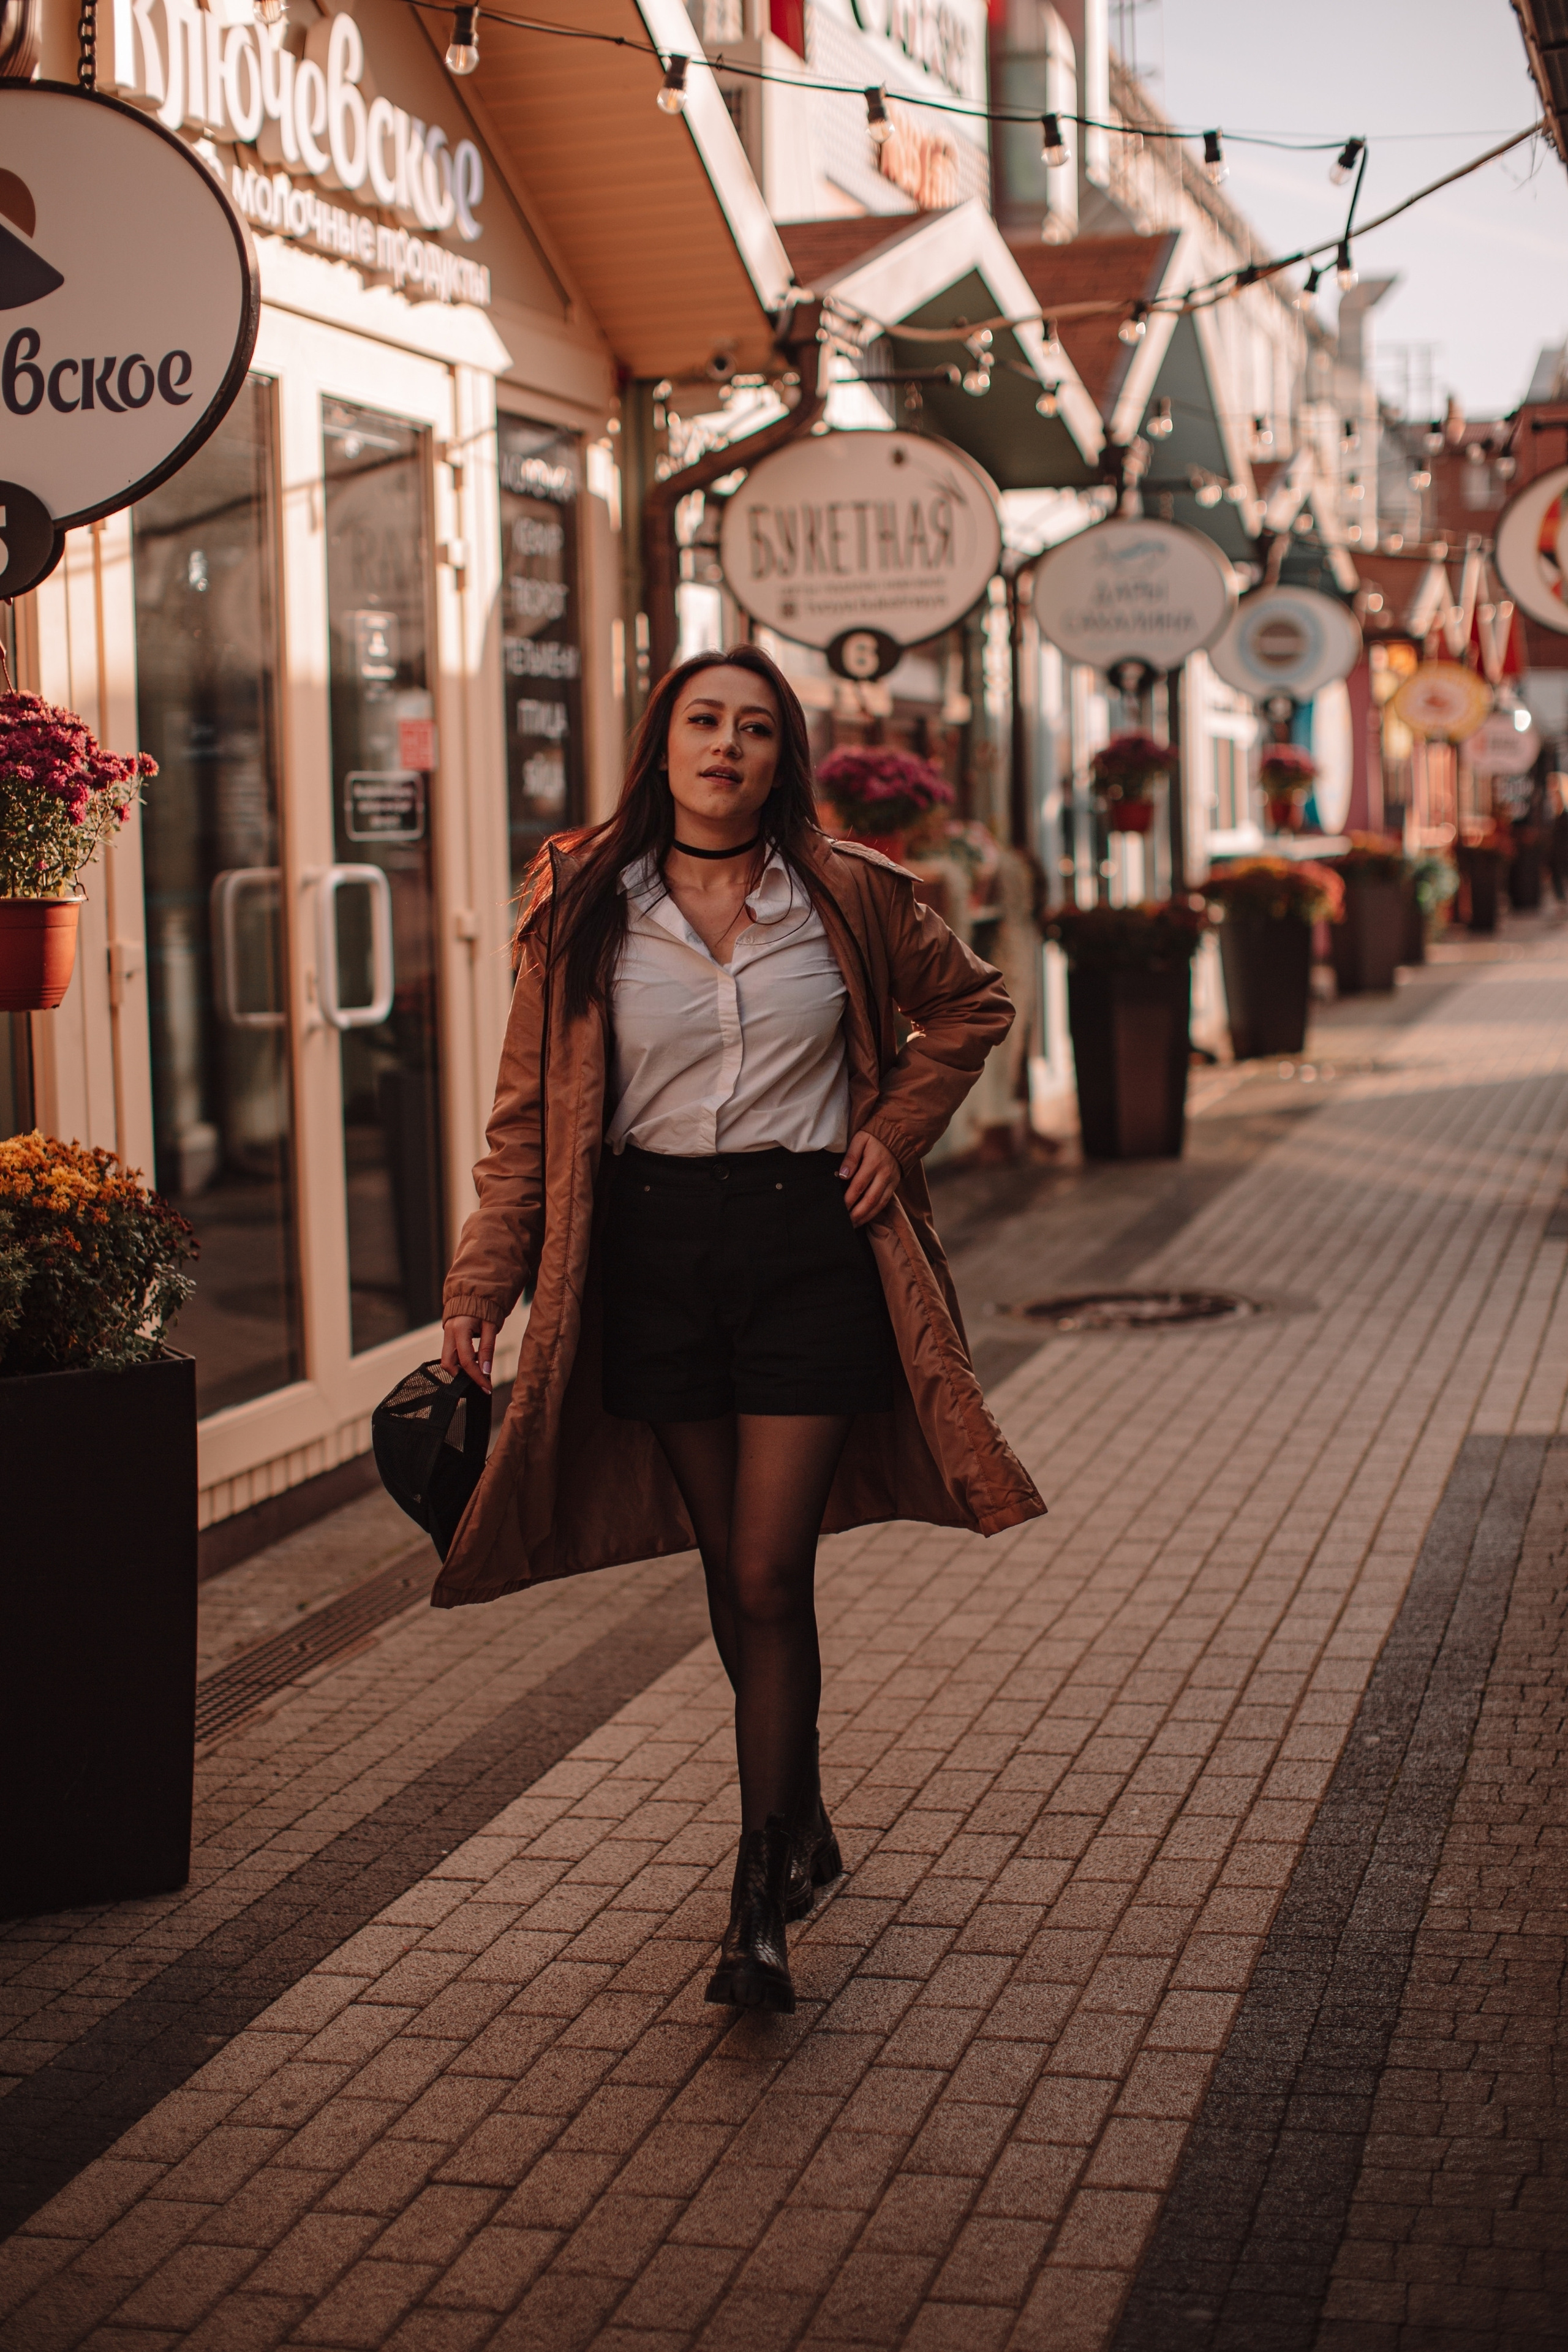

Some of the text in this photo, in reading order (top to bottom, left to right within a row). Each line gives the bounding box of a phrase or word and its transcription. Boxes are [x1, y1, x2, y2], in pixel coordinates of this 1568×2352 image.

[232, 164, 490, 305] молочные продукты
[2, 327, 193, 415] вское
[747, 496, 954, 580] БУКЕТНАЯ
[842, 631, 880, 677] 6
